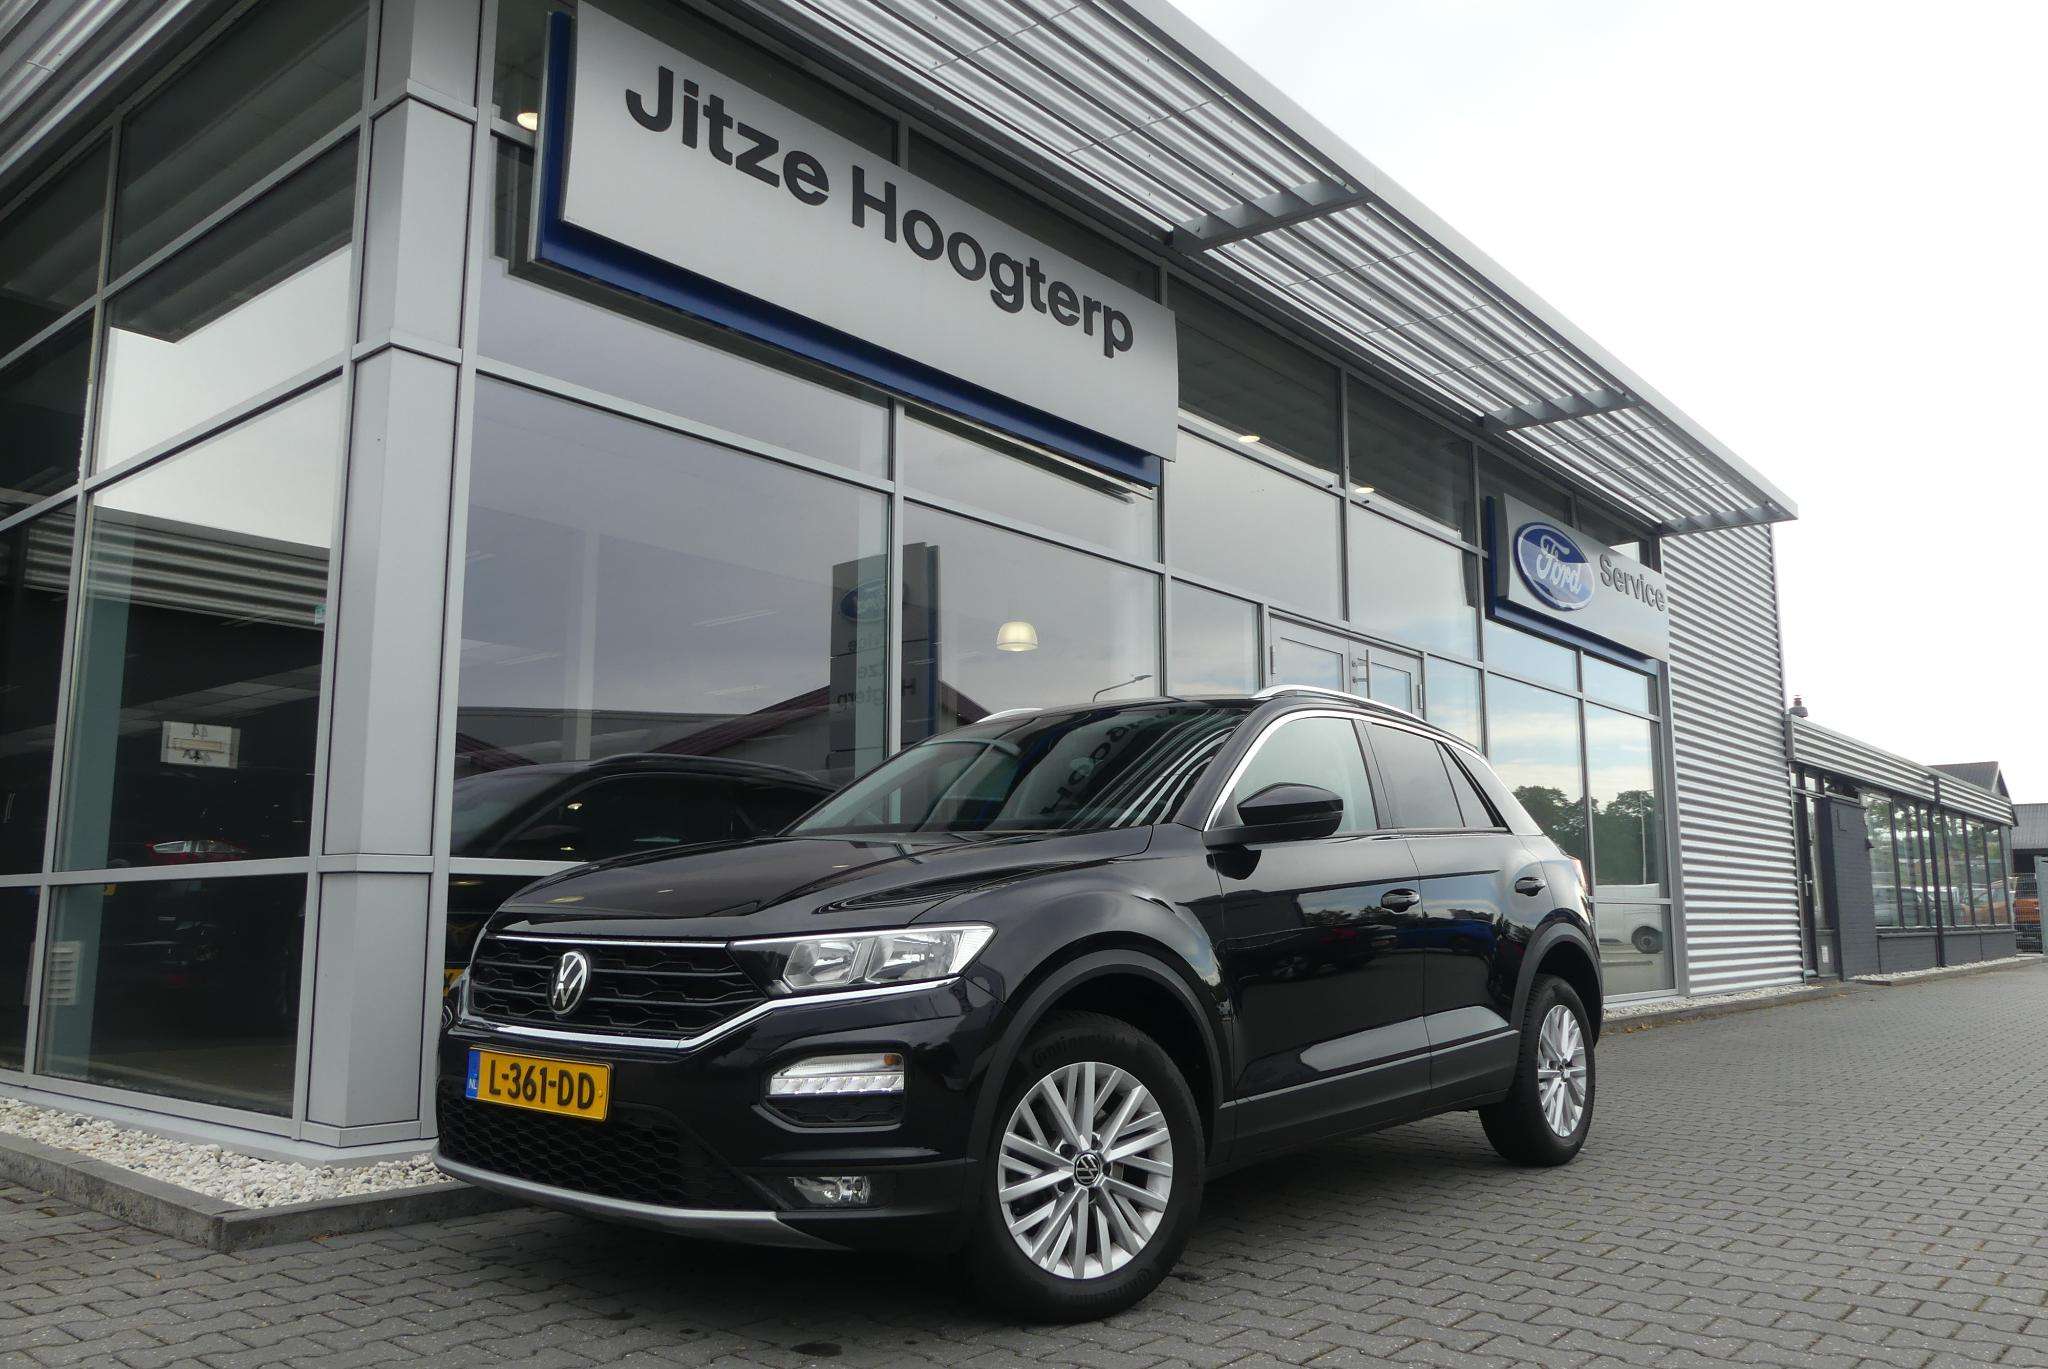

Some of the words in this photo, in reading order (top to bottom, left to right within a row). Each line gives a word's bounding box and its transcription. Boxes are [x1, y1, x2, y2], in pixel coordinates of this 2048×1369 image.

[625, 65, 830, 207] Jitze
[851, 164, 1135, 358] Hoogterp
[1535, 533, 1583, 594] Ford
[1599, 553, 1667, 612] Service
[488, 1059, 596, 1110] L-361-DD
